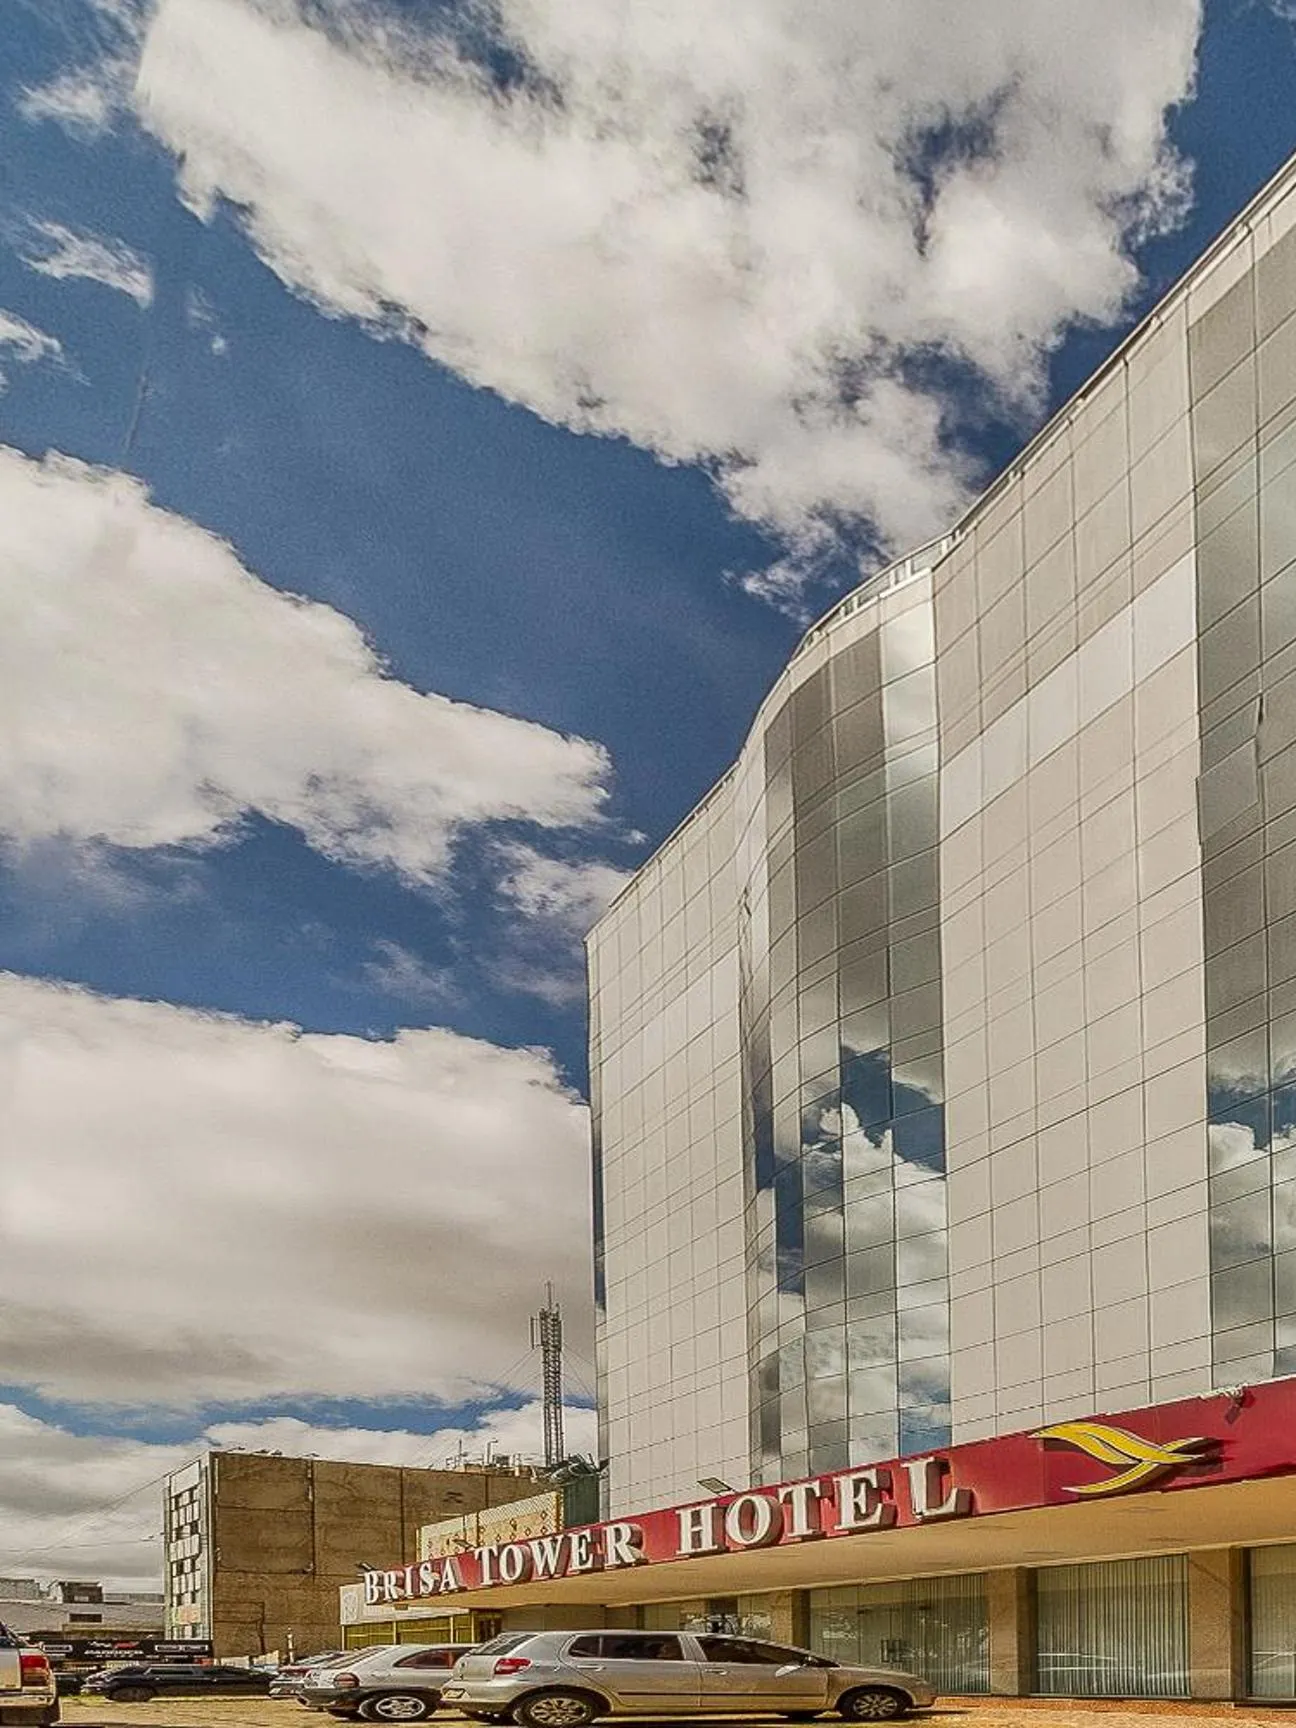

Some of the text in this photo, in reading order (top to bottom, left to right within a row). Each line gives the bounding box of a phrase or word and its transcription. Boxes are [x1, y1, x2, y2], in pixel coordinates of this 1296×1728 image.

[364, 1457, 960, 1604] BRISA TOWER HOTEL
